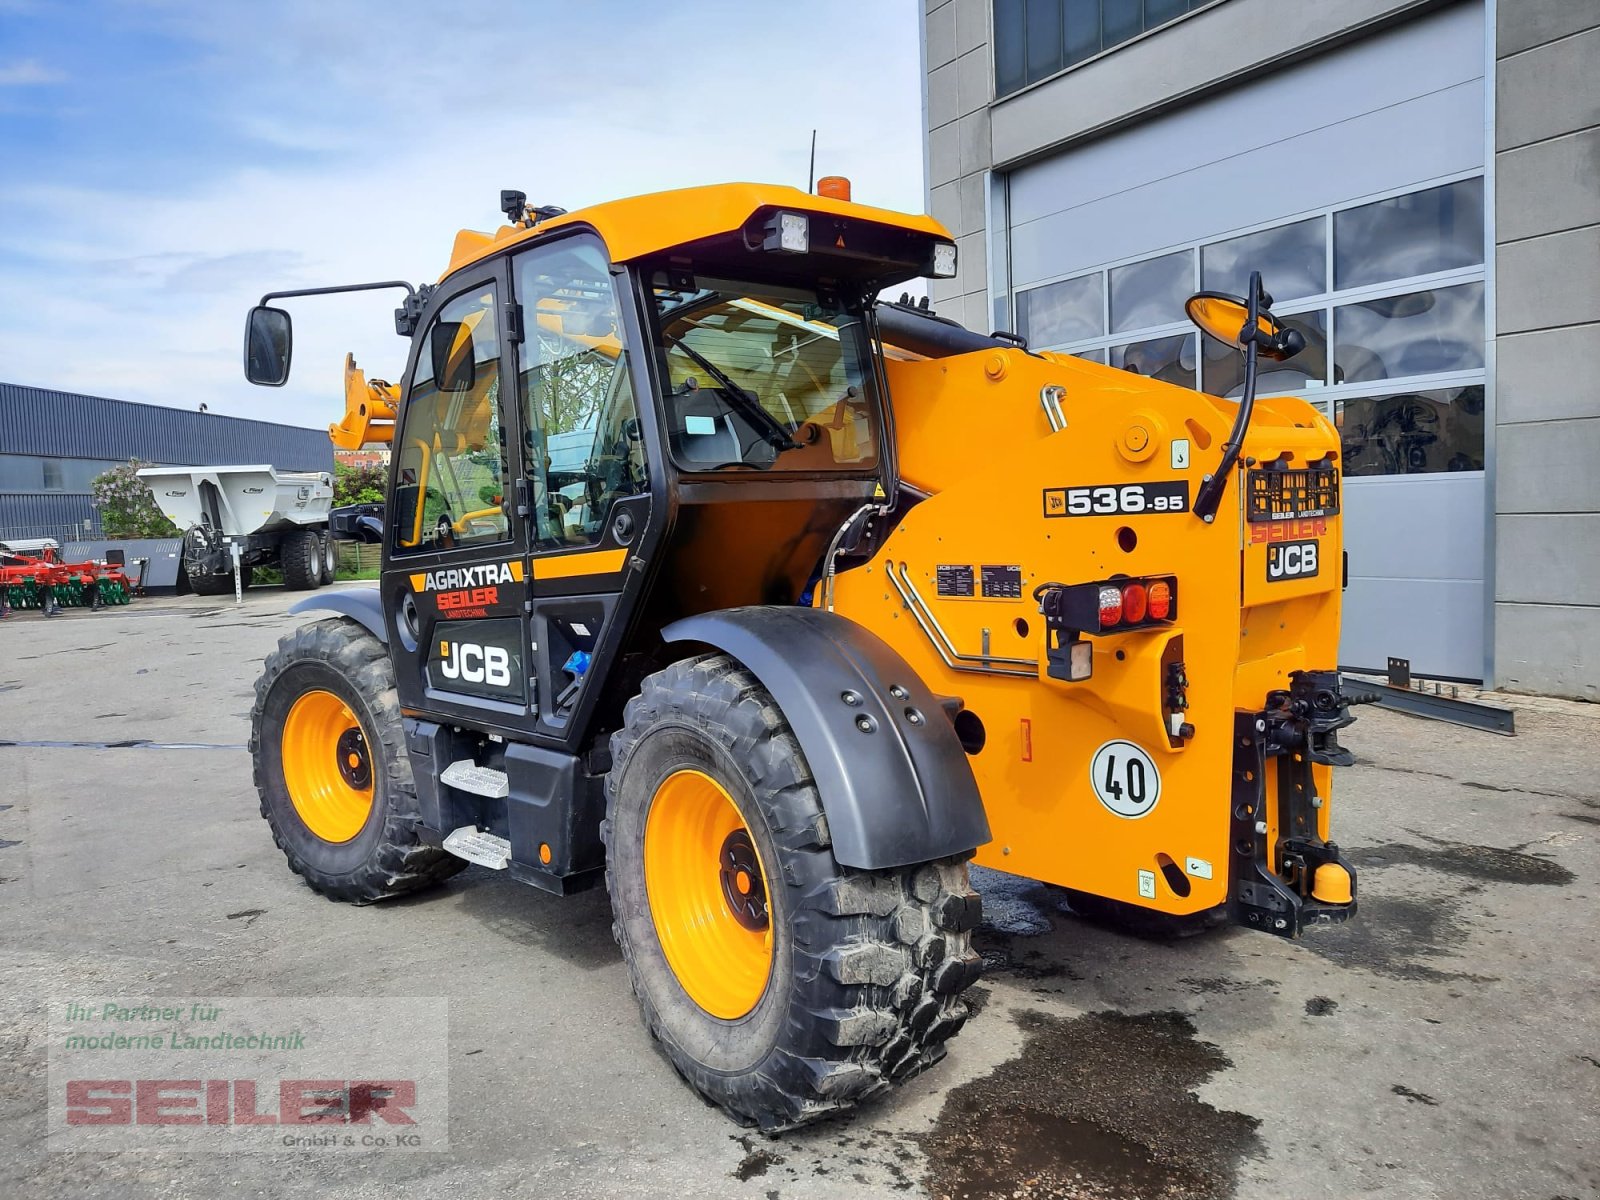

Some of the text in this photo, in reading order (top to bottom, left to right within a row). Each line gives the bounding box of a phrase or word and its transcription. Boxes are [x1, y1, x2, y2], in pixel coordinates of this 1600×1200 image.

[1272, 511, 1294, 519] SEILER
[1251, 519, 1326, 543] SEILER
[1270, 544, 1317, 576] JCB
[425, 562, 514, 591] AGRIXTRA
[436, 586, 499, 610] SEILER
[444, 607, 488, 619] LANDTECHNIK
[441, 641, 511, 687] JCB
[1105, 754, 1146, 804] 40
